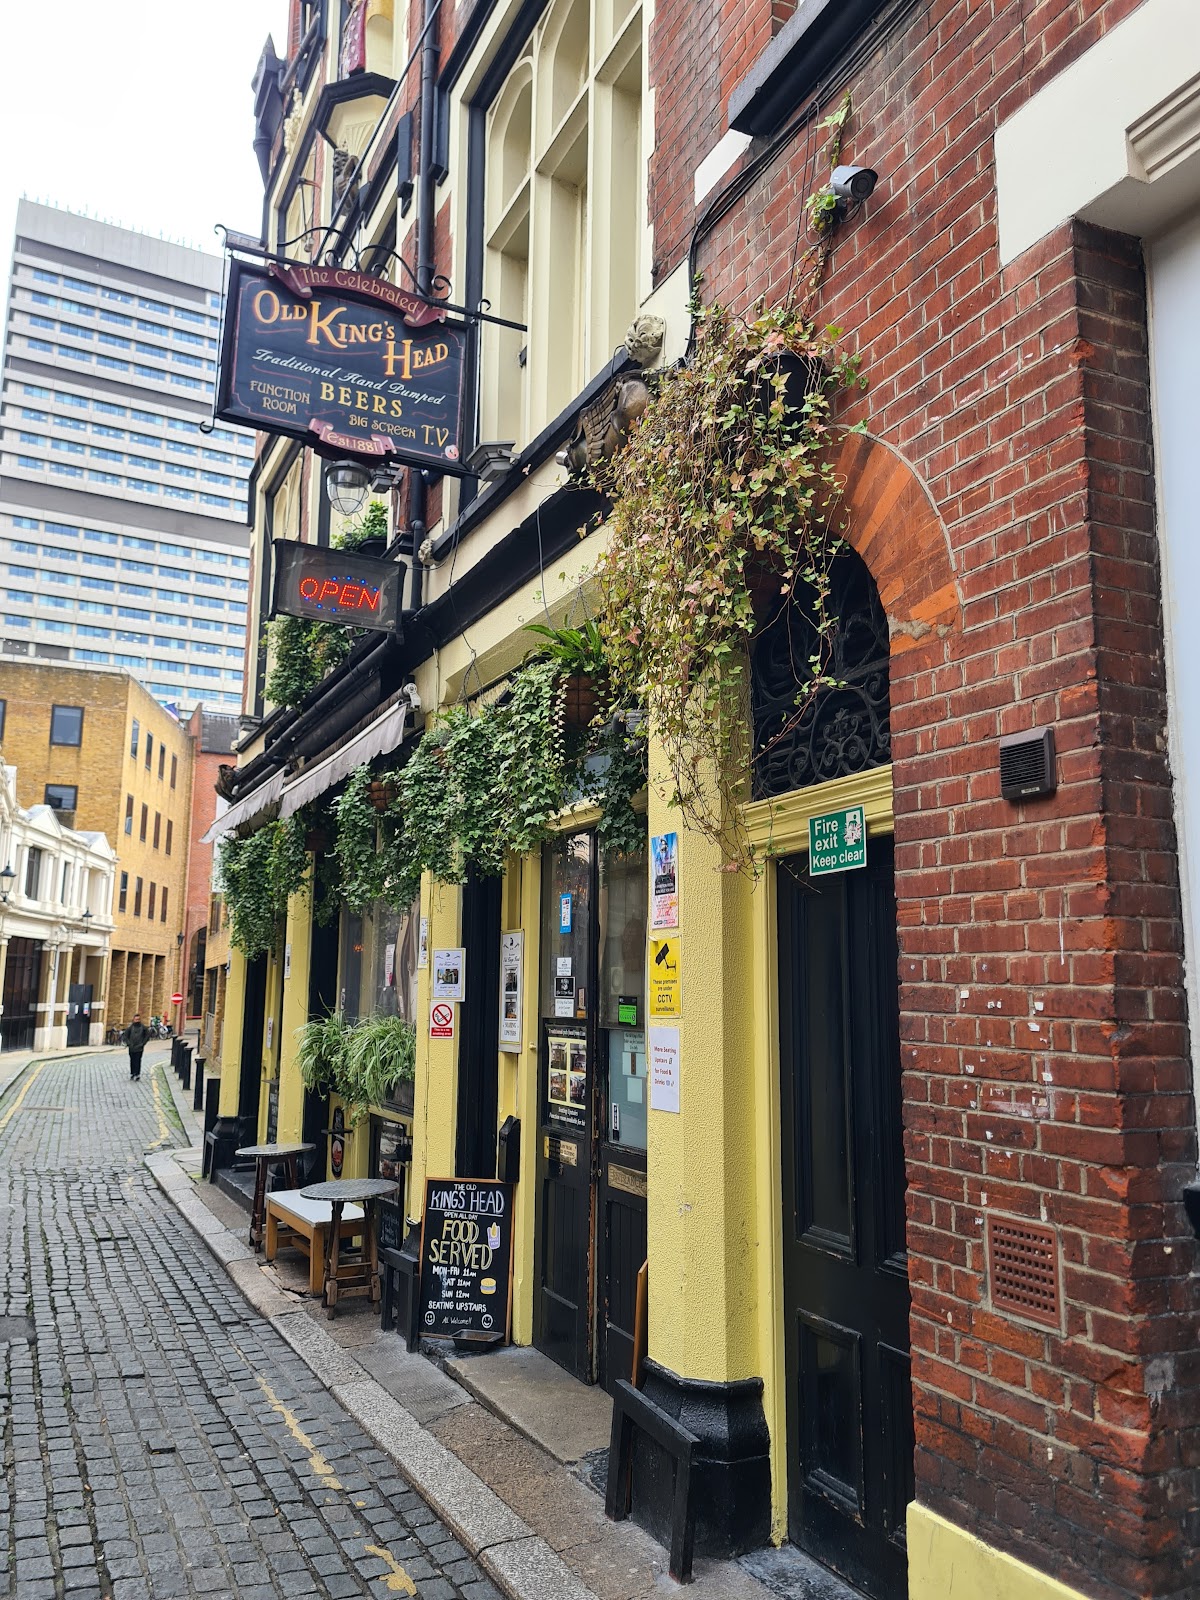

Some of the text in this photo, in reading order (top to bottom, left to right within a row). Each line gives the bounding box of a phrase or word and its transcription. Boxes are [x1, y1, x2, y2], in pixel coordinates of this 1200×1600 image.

[300, 268, 420, 314] The Celebrated
[252, 348, 446, 406] Traditional Hand Pumped
[250, 380, 310, 405] FUNCTION
[320, 381, 403, 418] BEERS
[262, 396, 297, 415] ROOM
[349, 413, 369, 428] BIG
[371, 419, 416, 440] SCREEN
[300, 578, 380, 610] OPEN
[814, 818, 839, 836] Fire
[815, 833, 838, 852] exit
[812, 849, 864, 869] Keep clear
[658, 994, 672, 1003] CCTV
[664, 1046, 676, 1055] Seating
[430, 1190, 504, 1214] KINGS HEAD
[442, 1220, 480, 1244] FOOD
[428, 1238, 493, 1270] SERVED
[432, 1264, 460, 1276] MON-FRI
[442, 1278, 471, 1287] SAT 11AM
[442, 1290, 470, 1298] SUN 12PM
[428, 1300, 486, 1313] SEATING UPSTAIRS
